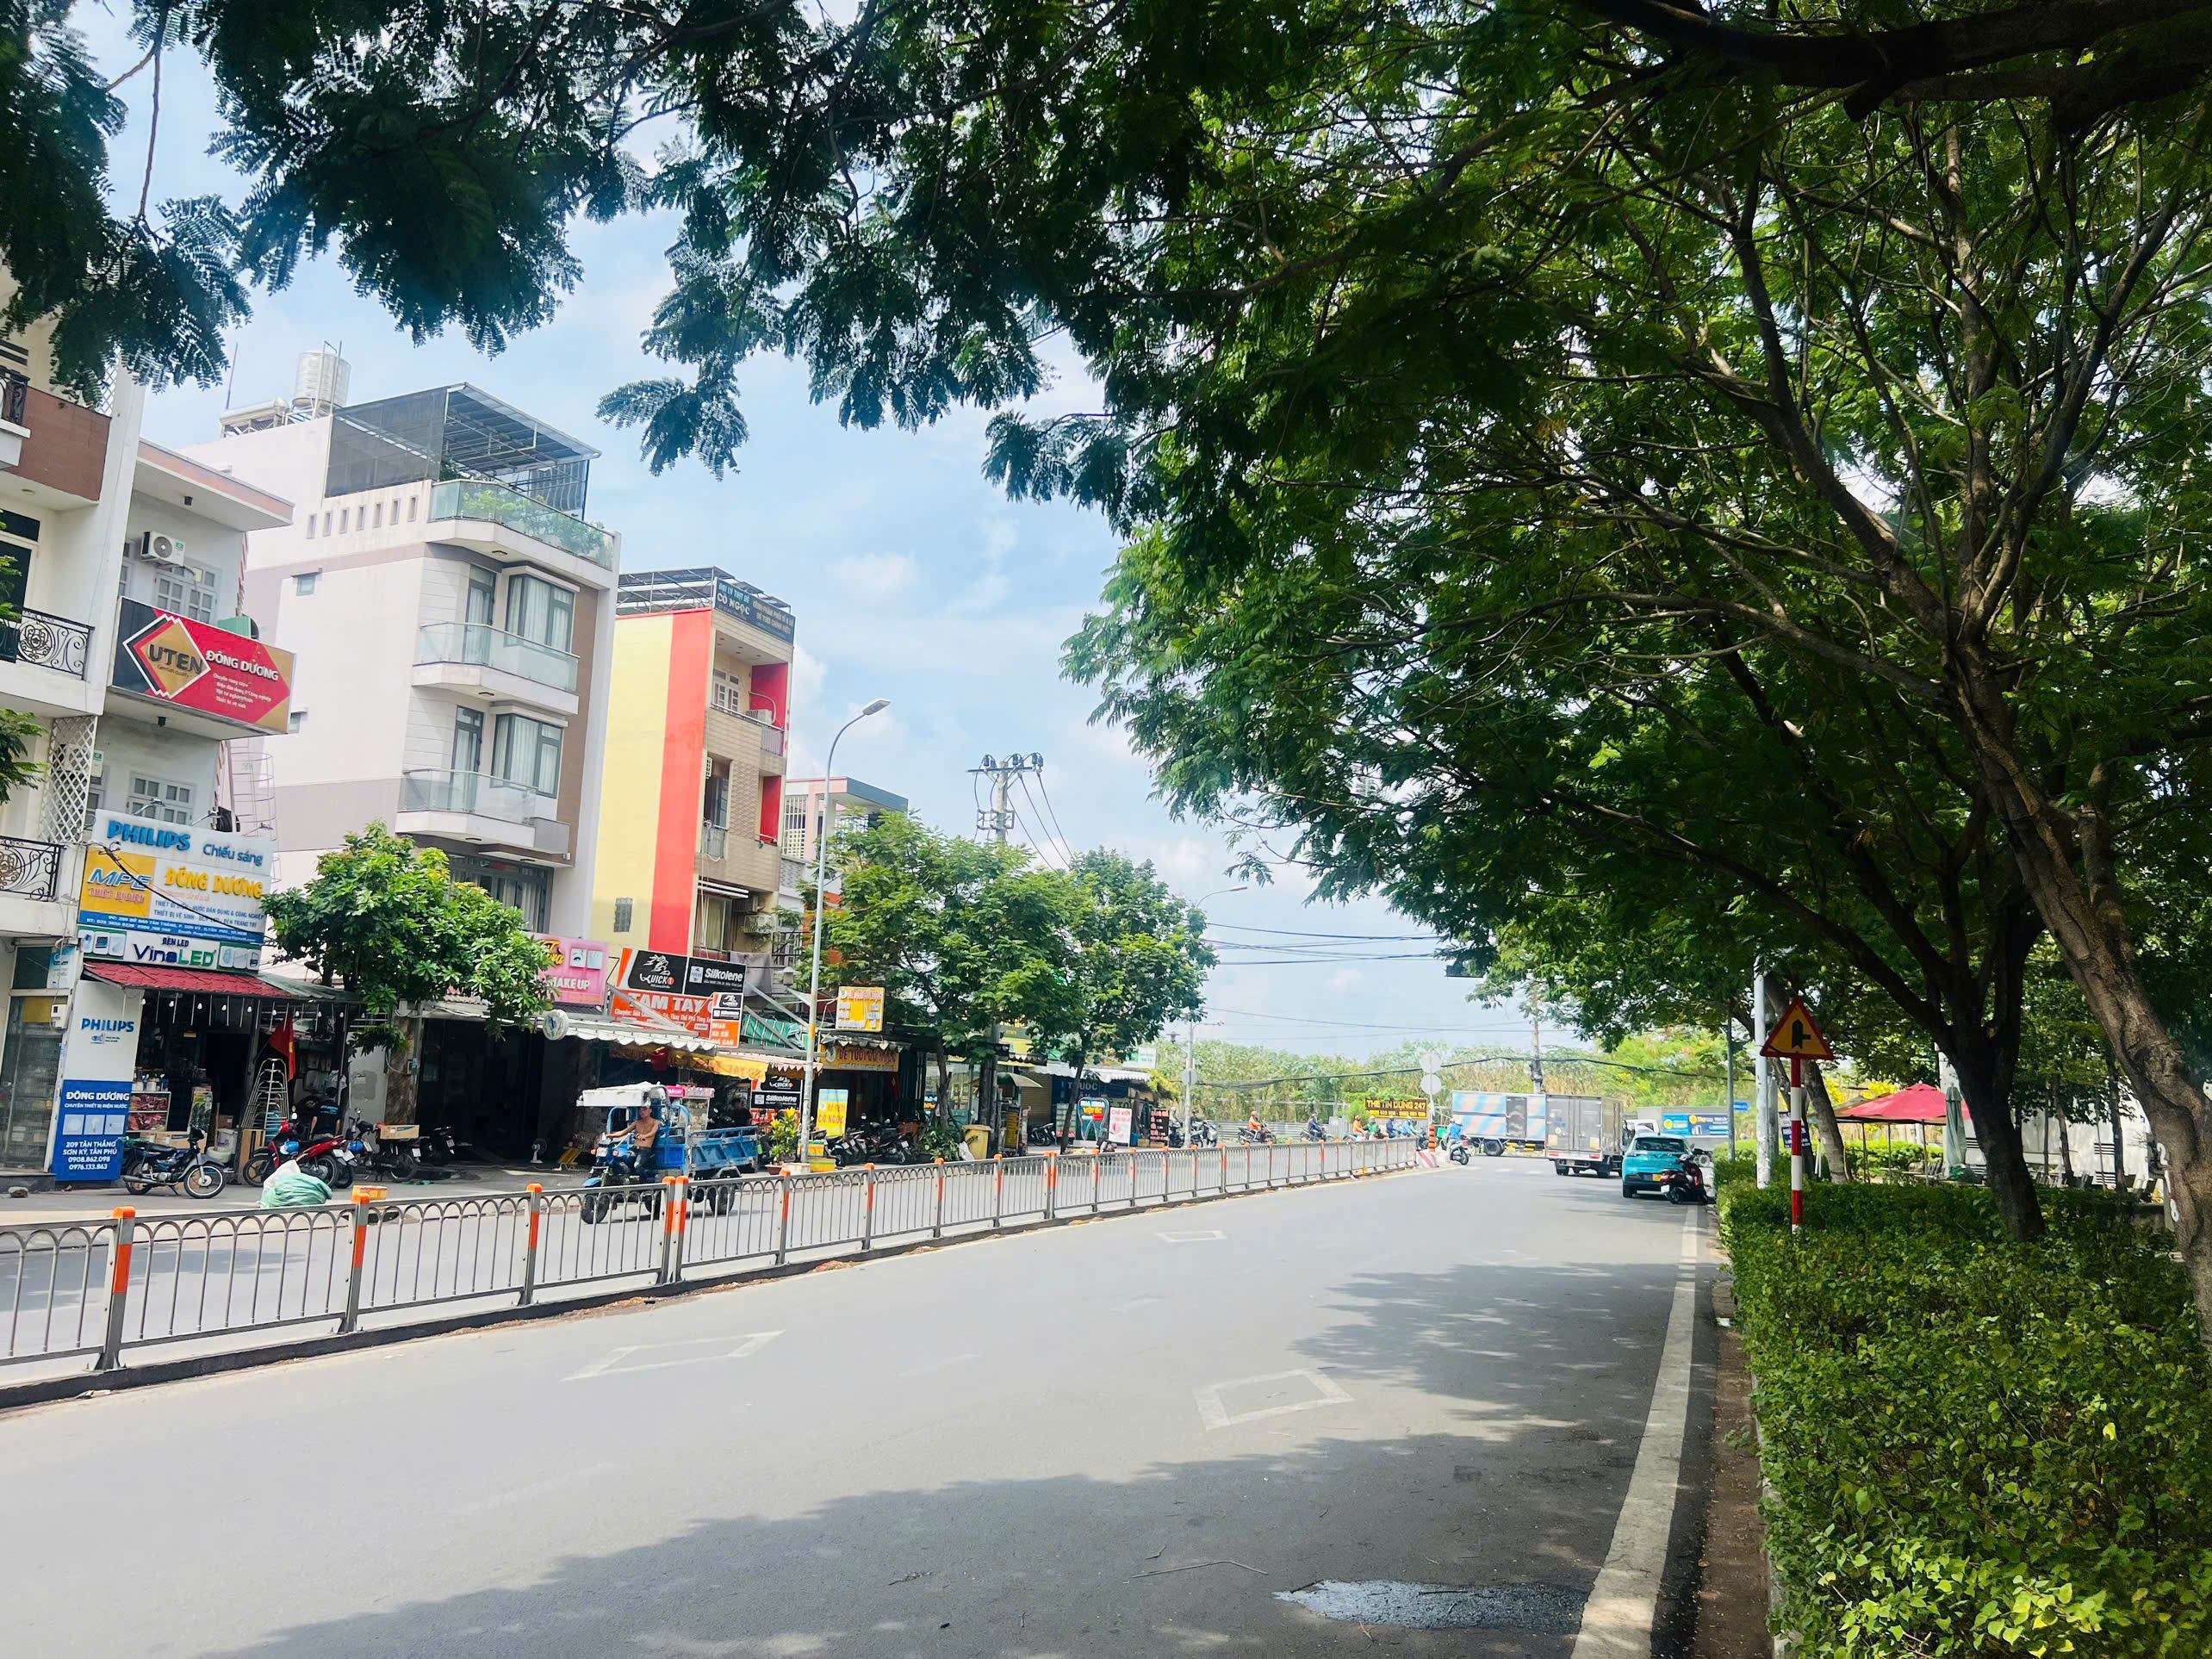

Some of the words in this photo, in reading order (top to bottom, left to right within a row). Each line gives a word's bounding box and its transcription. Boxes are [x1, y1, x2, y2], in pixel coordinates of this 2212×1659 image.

[717, 593, 728, 605] CÔ
[729, 598, 750, 615] NGỌC
[147, 643, 202, 674] UTEN
[206, 649, 239, 669] ĐÔNG
[240, 659, 279, 680] DƯƠNG
[107, 819, 191, 851] PHILIPS
[202, 842, 235, 860] Chiếu
[237, 849, 264, 867] sáng
[87, 868, 152, 892] MPE
[165, 866, 208, 891] ĐÔNG
[212, 873, 264, 899] DƯƠNG
[163, 935, 177, 947] ĐÈN
[177, 938, 190, 948] LED
[133, 944, 214, 967] VinaLED
[577, 979, 590, 990] UP
[705, 967, 743, 982] Silkolene
[81, 1018, 134, 1033] PHILIPS
[65, 1090, 95, 1101] ĐÔNG
[96, 1091, 130, 1101] DƯƠNG
[93, 1139, 116, 1147] THẮNG
